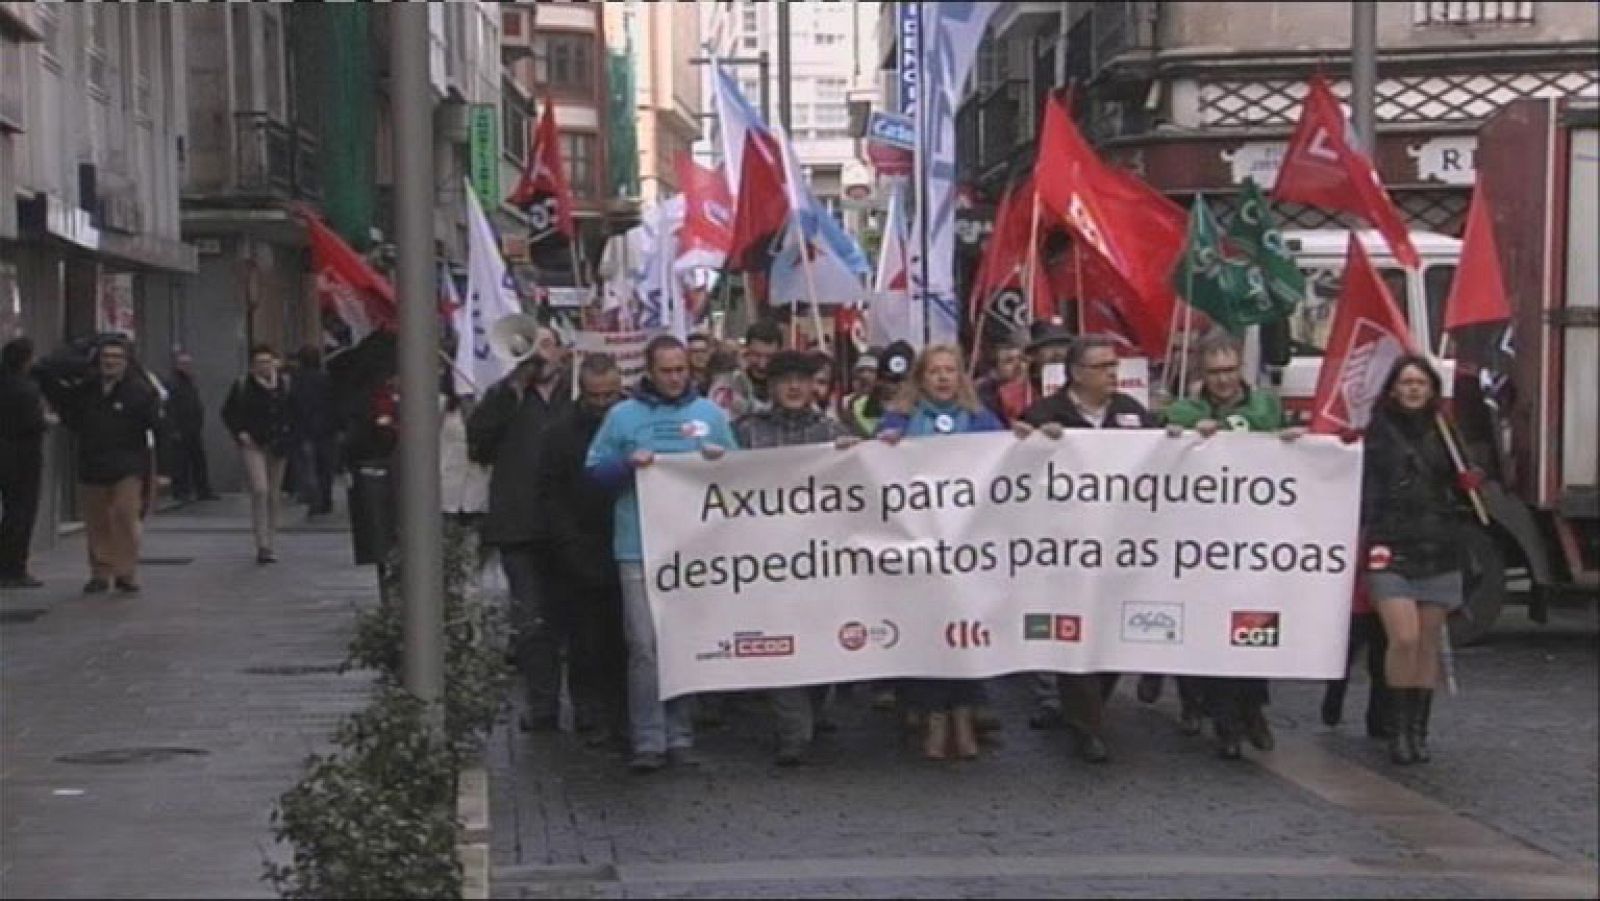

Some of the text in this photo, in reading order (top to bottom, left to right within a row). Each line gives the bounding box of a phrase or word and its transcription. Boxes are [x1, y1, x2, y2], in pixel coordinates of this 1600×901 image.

[702, 461, 1298, 522] Axudas para os banqueiros
[656, 536, 1347, 593] despedimentos para as persoas
[1232, 627, 1279, 646] CGT
